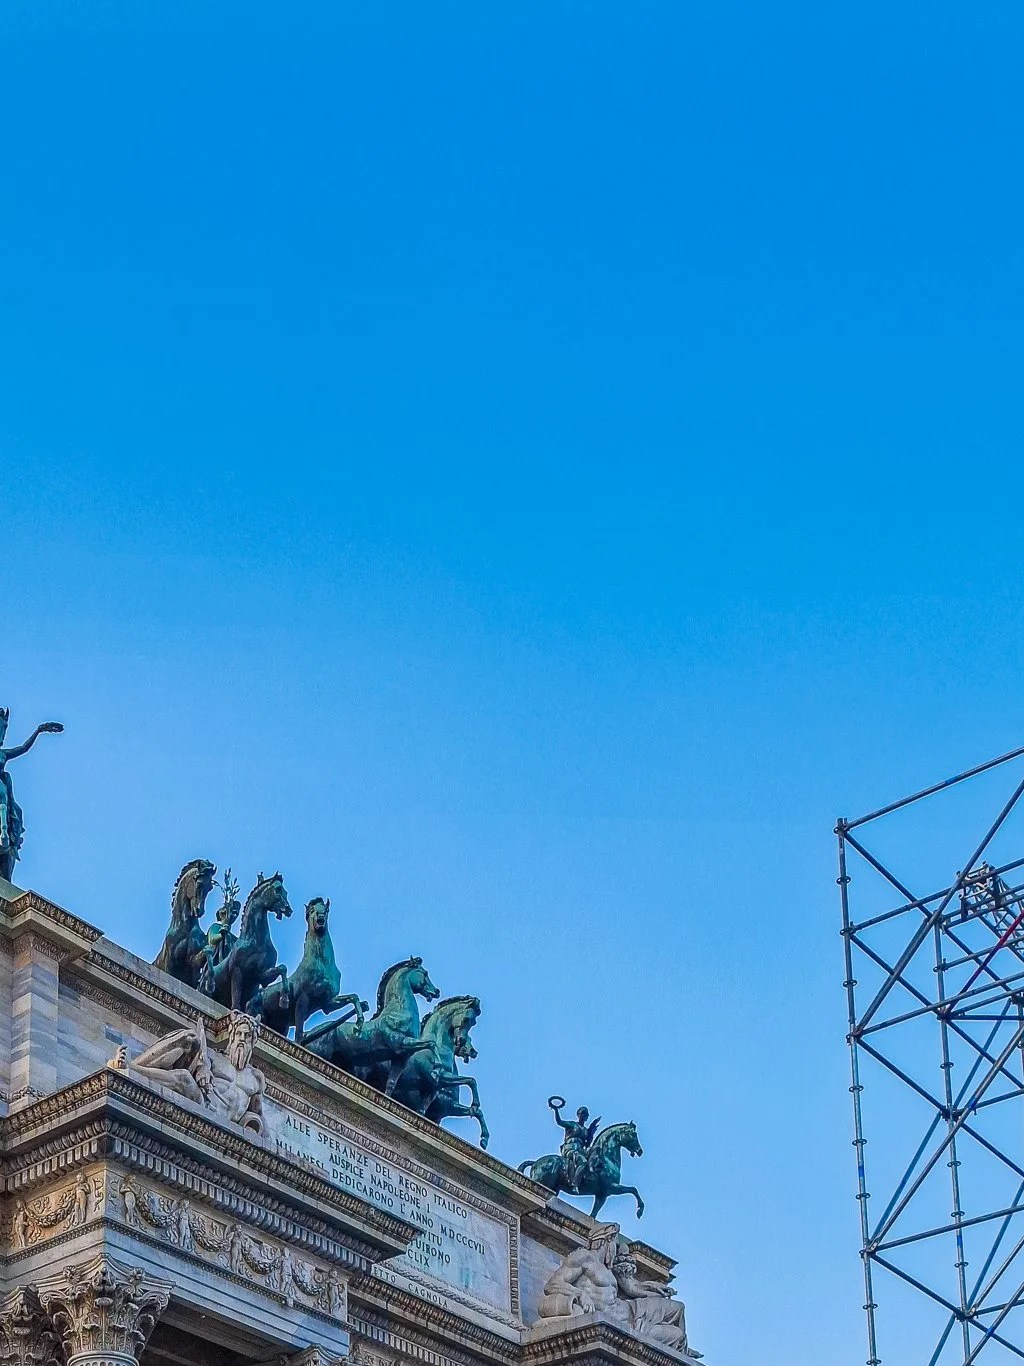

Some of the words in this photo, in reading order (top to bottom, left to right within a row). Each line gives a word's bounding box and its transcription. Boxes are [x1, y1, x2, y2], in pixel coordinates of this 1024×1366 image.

[285, 1115, 311, 1136] ALLE
[317, 1132, 369, 1167] SPERANZE
[375, 1163, 392, 1179] DEL
[399, 1174, 428, 1198] REGNO
[434, 1194, 467, 1219] ITALICO
[329, 1153, 364, 1179] AUSPICE
[370, 1174, 420, 1209] NAPOLEONE
[332, 1168, 394, 1208] DEDICARONO
[409, 1209, 434, 1228] ANNO
[440, 1223, 485, 1255] MDCCCVII
[407, 1248, 430, 1268] CLIX
[421, 1231, 443, 1247] VITU
[373, 1266, 396, 1283] ETTO
[408, 1282, 448, 1309] CAGNOLA
